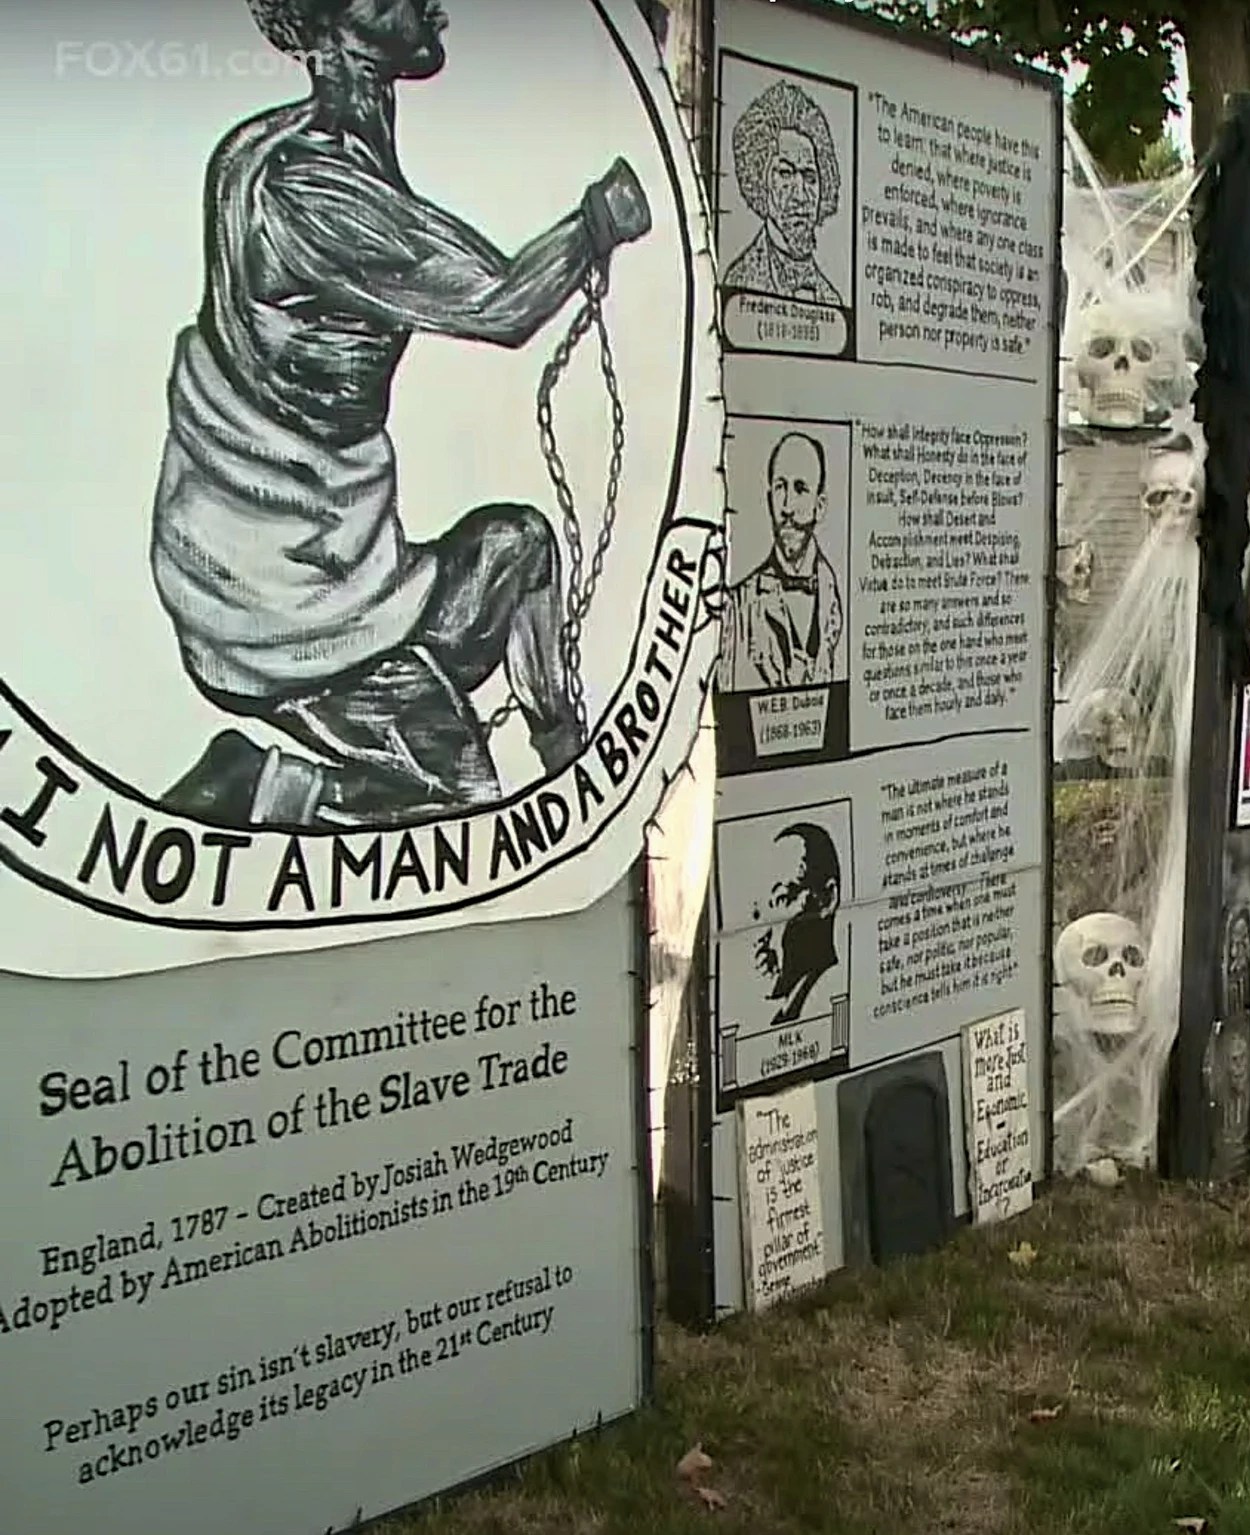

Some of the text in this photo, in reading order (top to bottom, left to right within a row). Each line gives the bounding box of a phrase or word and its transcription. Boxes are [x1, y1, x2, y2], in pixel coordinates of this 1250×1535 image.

[1, 548, 696, 912] I NOT A MAN AND A BROTHER
[39, 982, 577, 1116] Seal of the Committee for the
[50, 1042, 568, 1187] Abolition of the Slave Trade
[987, 1074, 1011, 1092] and
[39, 1221, 163, 1276] England,
[171, 1206, 228, 1243] 1787
[257, 1176, 346, 1221] Created
[351, 1172, 379, 1201] by
[380, 1151, 448, 1195] Josiah
[451, 1118, 574, 1171] Wedgewood
[120, 1271, 155, 1304] by
[160, 1237, 285, 1290] American
[289, 1196, 428, 1254] Abolitionists
[432, 1189, 453, 1215] in
[458, 1180, 490, 1207] the
[493, 1165, 529, 1197] 19th
[533, 1151, 610, 1186] Century
[43, 1265, 573, 1452] Perhaps our sin isn't slavery, but our refusal to
[78, 1305, 554, 1485] acknowledge its legacy in the 21st Century
